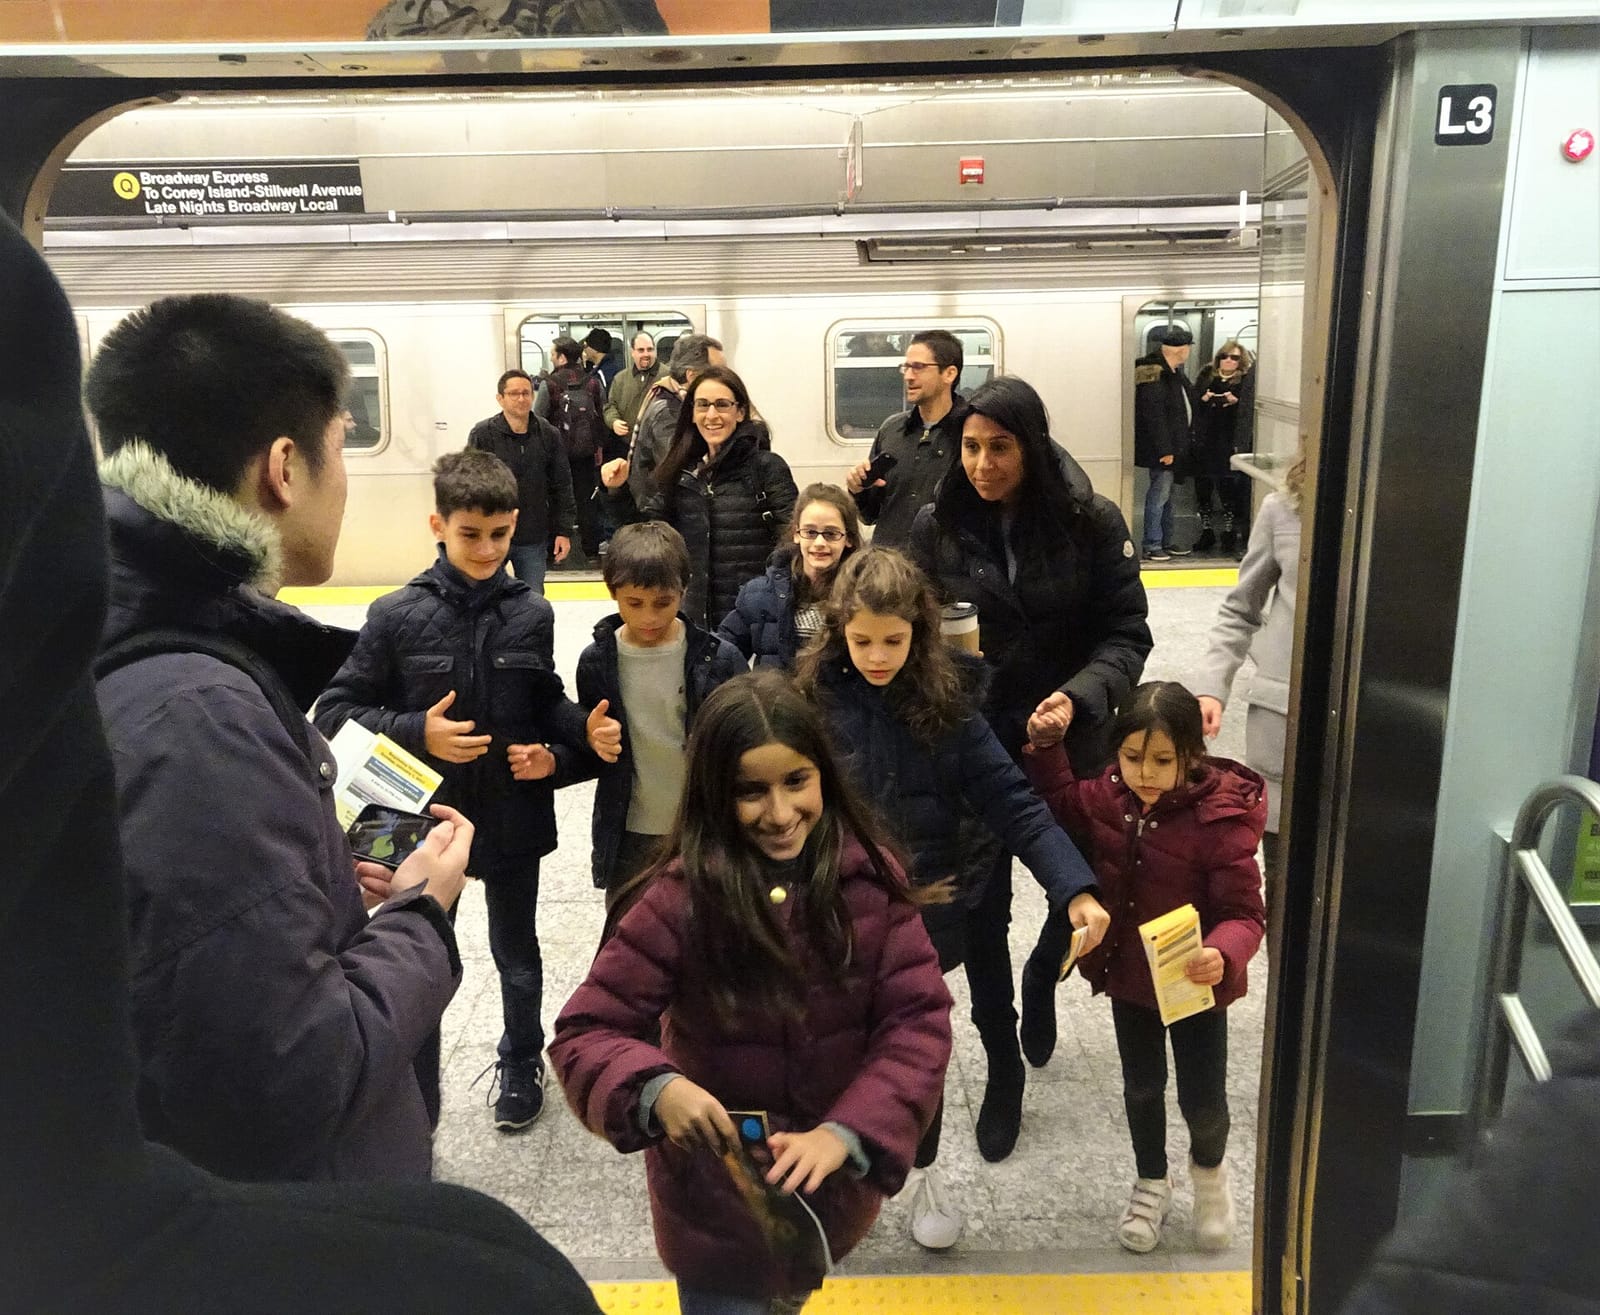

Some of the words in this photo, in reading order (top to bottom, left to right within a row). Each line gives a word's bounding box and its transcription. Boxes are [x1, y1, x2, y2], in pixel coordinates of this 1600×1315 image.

[1438, 95, 1493, 135] L3
[120, 178, 134, 194] Q
[140, 171, 210, 187] Broadway
[212, 170, 269, 186] Express
[142, 186, 160, 200] To
[161, 186, 205, 201] Coney
[208, 184, 309, 199] Island-Stillwell
[311, 184, 362, 197] Avenue
[145, 201, 177, 214] Late
[179, 200, 225, 215] Nights
[228, 199, 297, 214] Broadway
[300, 198, 339, 212] Local
